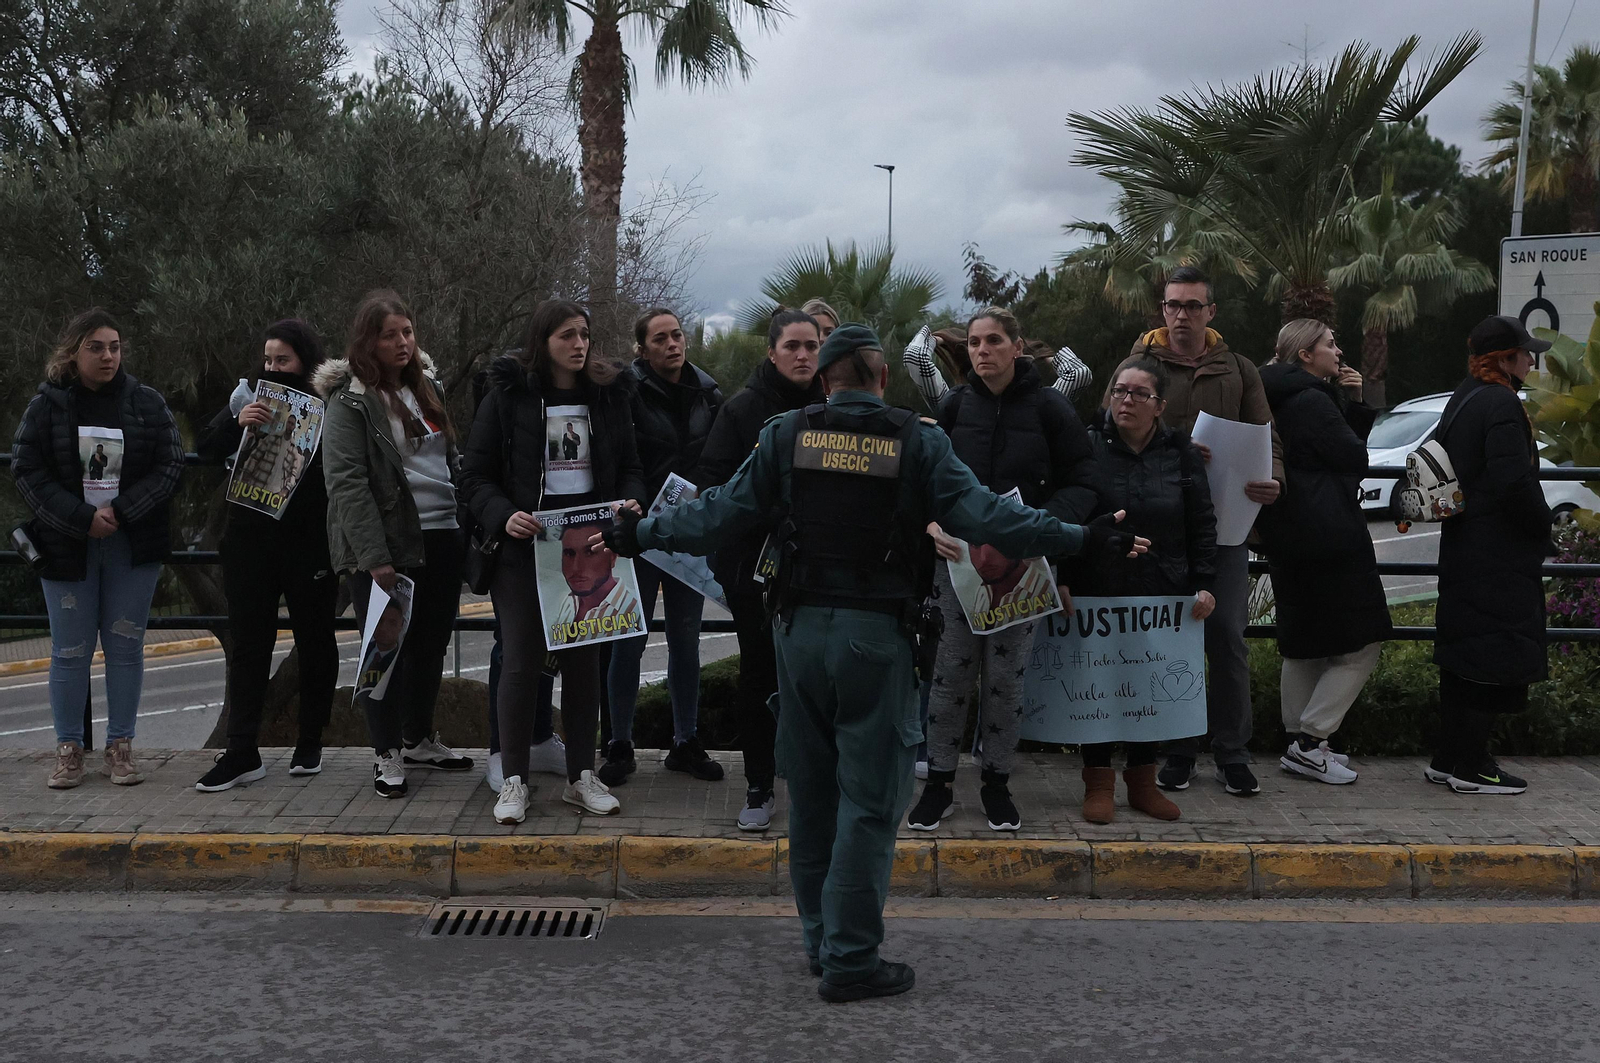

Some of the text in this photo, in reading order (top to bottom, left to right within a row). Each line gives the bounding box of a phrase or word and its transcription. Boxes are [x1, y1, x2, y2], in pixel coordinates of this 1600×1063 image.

[1510, 248, 1588, 264] SAN ROQUE
[801, 431, 896, 457] GUARDIA CIVIL
[822, 451, 870, 472] USECIC
[570, 511, 597, 524] somos
[598, 508, 616, 520] Salv
[971, 592, 1054, 630] ¡¡JUSTICIA!!
[1047, 601, 1184, 638] ¡JUSTICIA!
[551, 612, 638, 643] ¡¡JUSTICIA!!
[1061, 680, 1139, 702] Vuela alto
[1069, 704, 1159, 722] nuestro angelito
